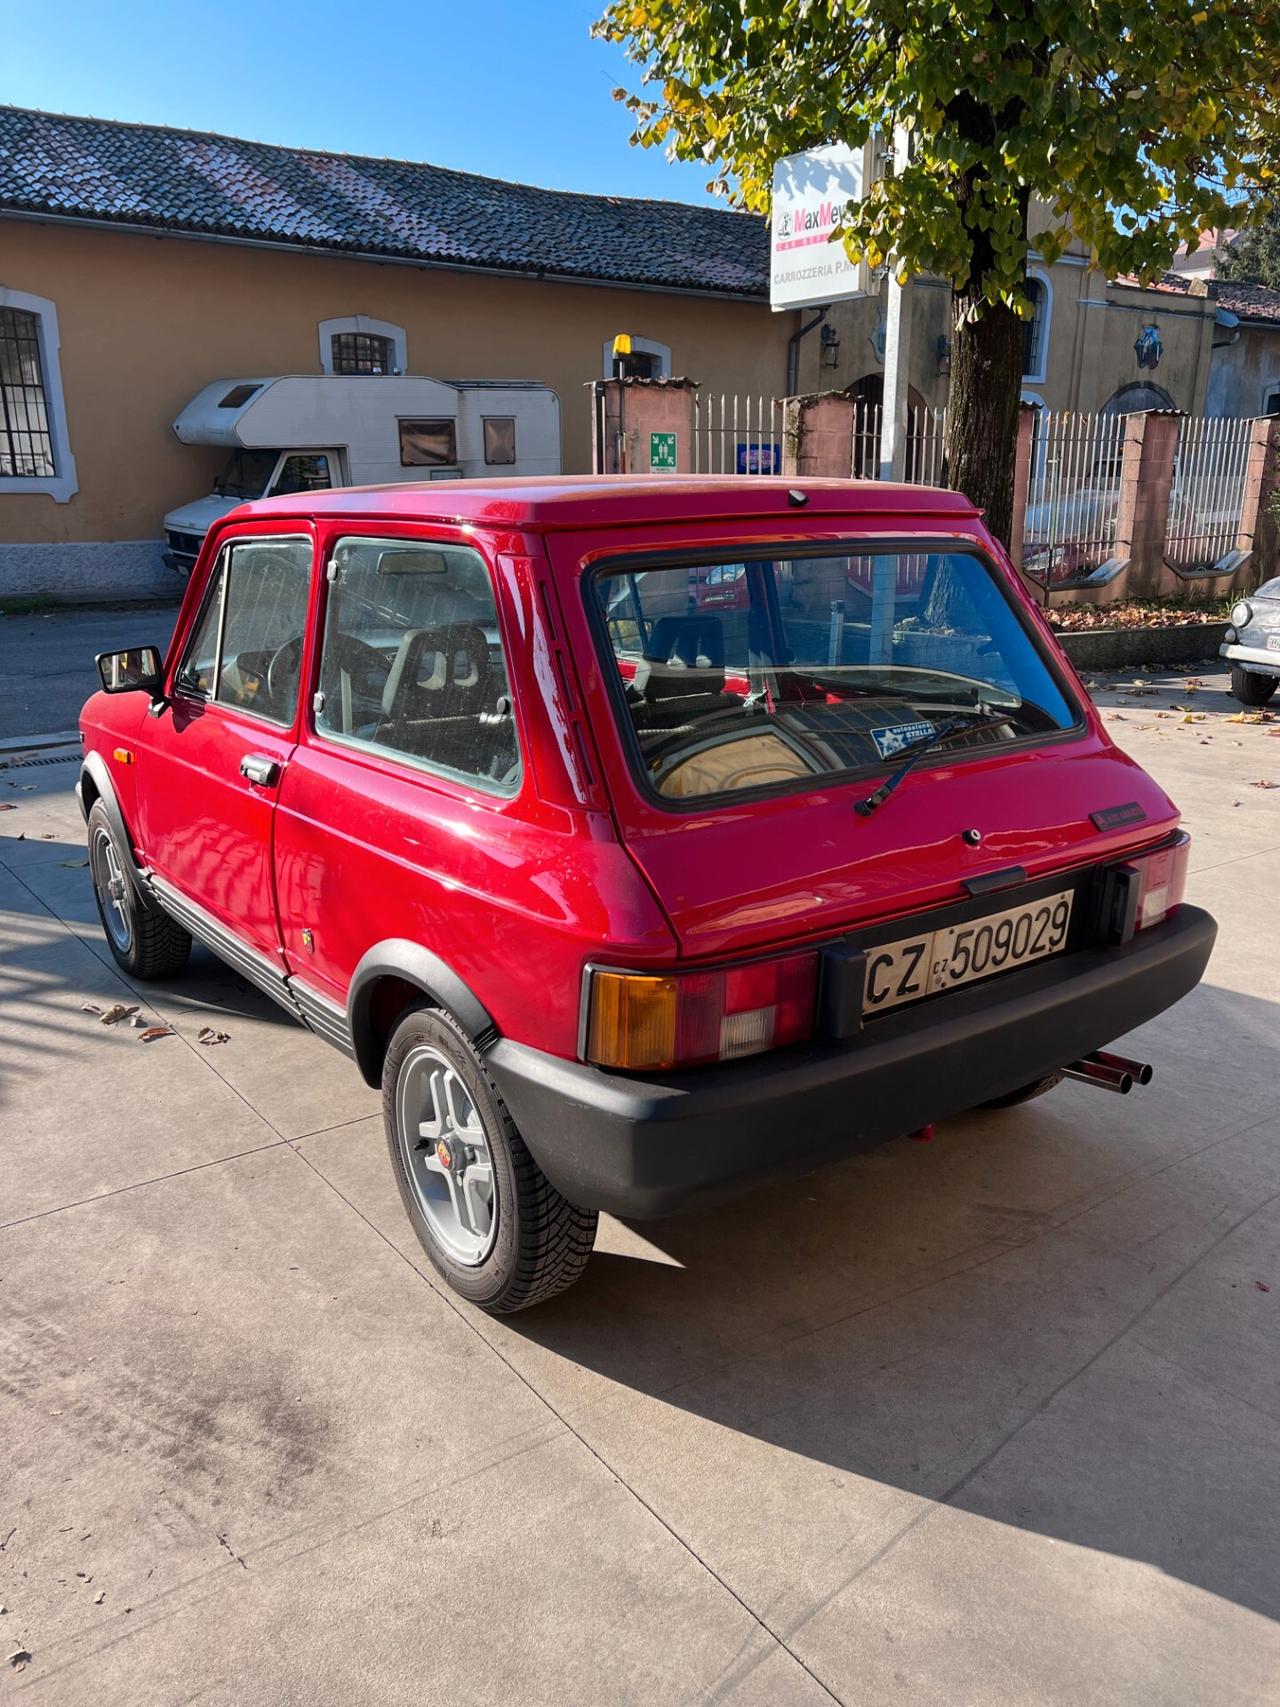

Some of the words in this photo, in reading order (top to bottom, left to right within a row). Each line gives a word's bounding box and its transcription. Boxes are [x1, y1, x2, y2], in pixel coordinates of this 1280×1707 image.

[794, 202, 846, 232] MaxMey
[774, 264, 833, 285] CARROZZERIA
[906, 728, 933, 738] STELLA
[866, 943, 926, 1004] CZ
[933, 959, 948, 974] CZ
[950, 901, 1070, 980] 509029
